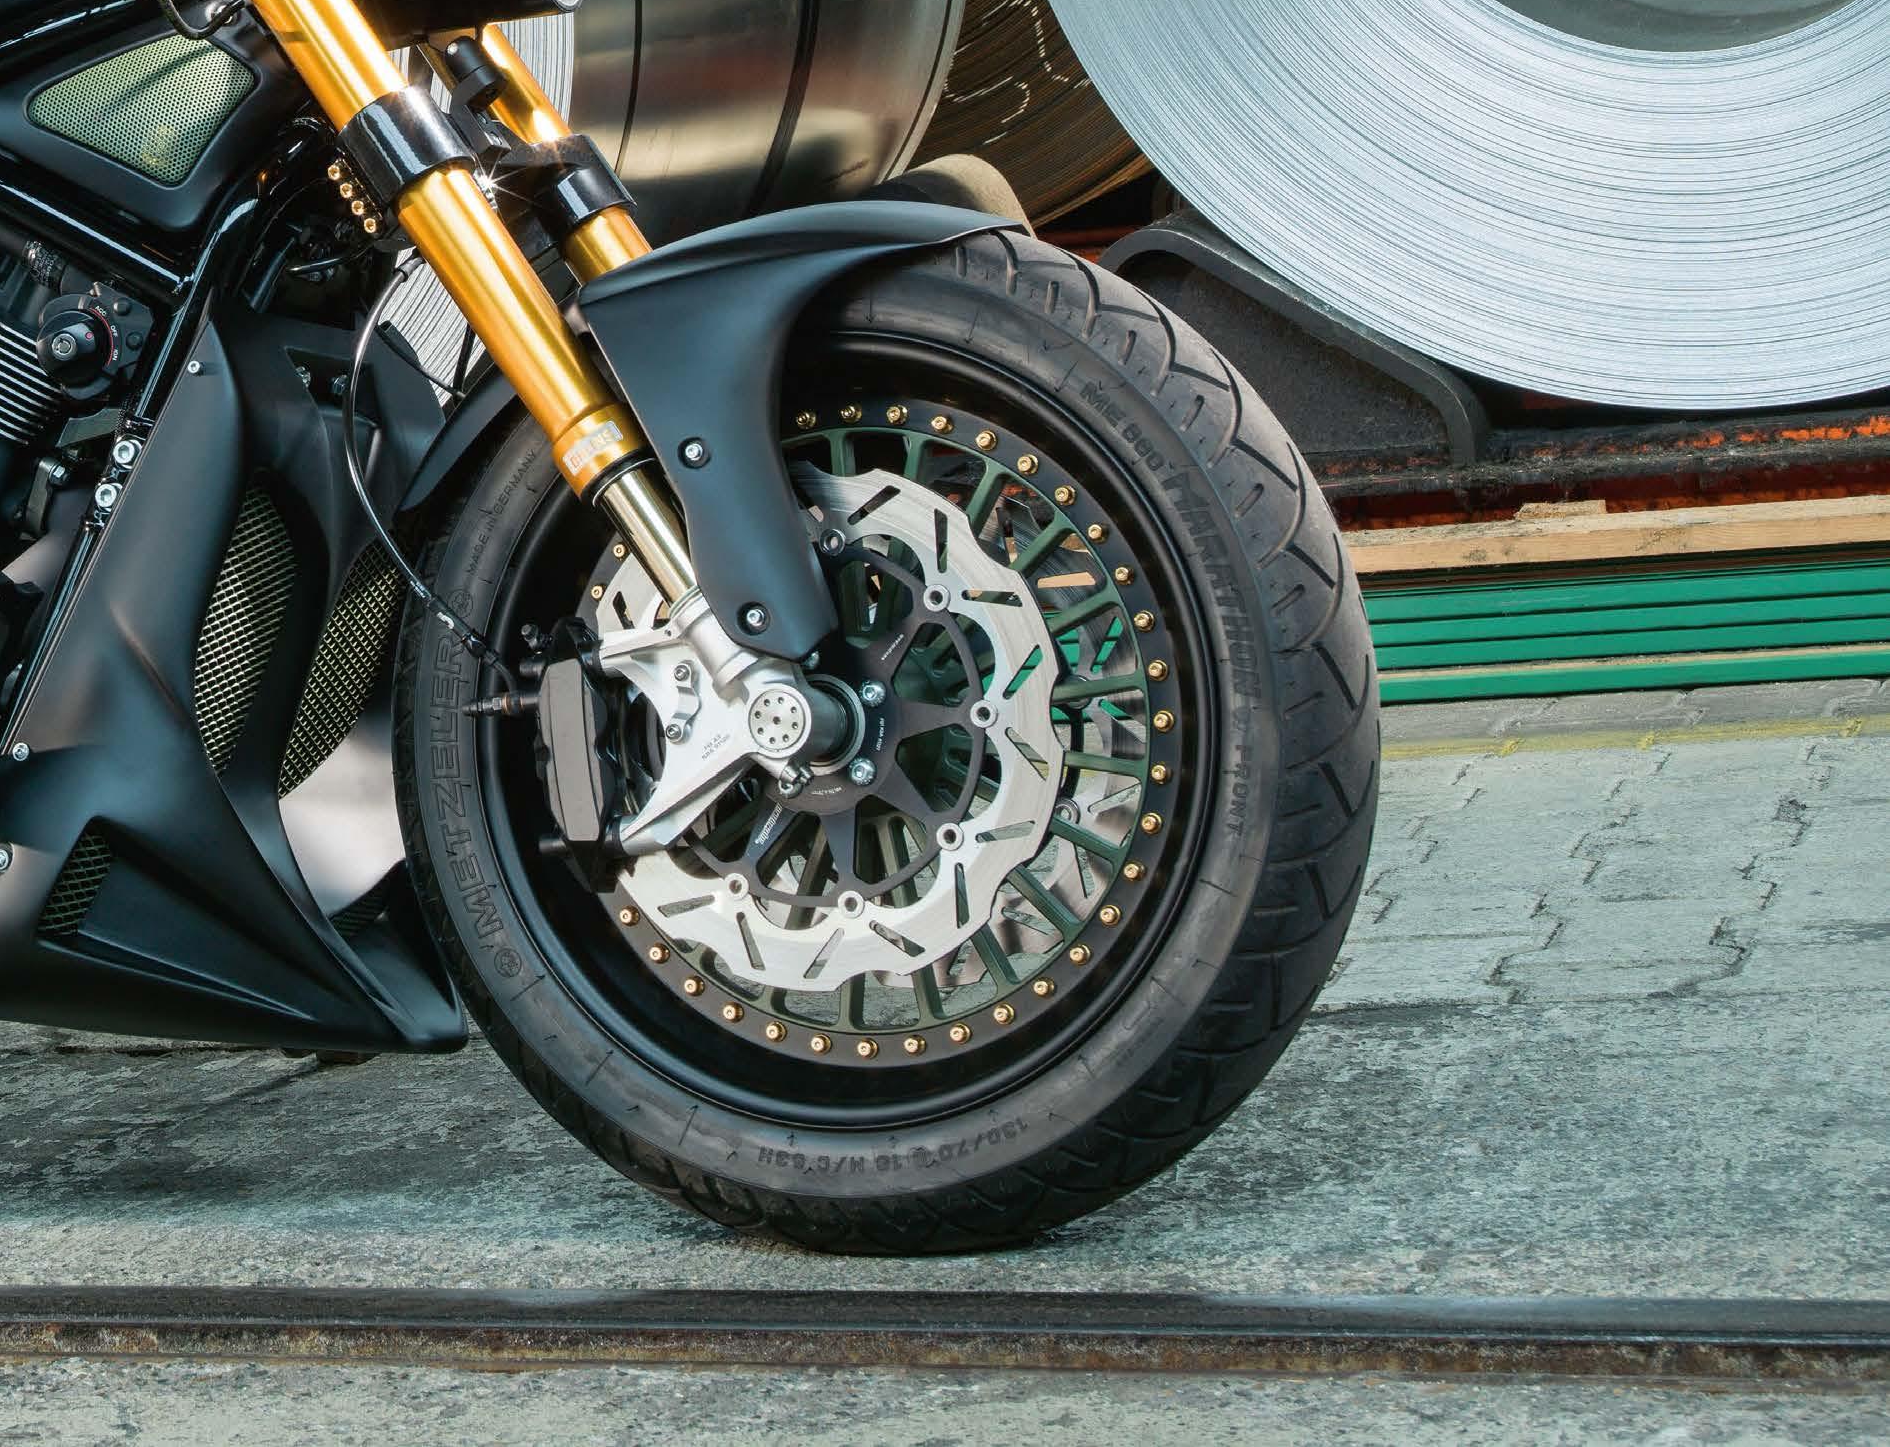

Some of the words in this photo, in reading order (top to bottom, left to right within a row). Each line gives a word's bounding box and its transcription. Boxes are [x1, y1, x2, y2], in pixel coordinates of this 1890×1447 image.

[94, 305, 108, 317] ACC
[110, 325, 119, 338] OFF
[465, 533, 490, 576] MADE
[486, 516, 498, 535] IN
[493, 448, 538, 515] GERMANY
[430, 634, 504, 939] METZELER
